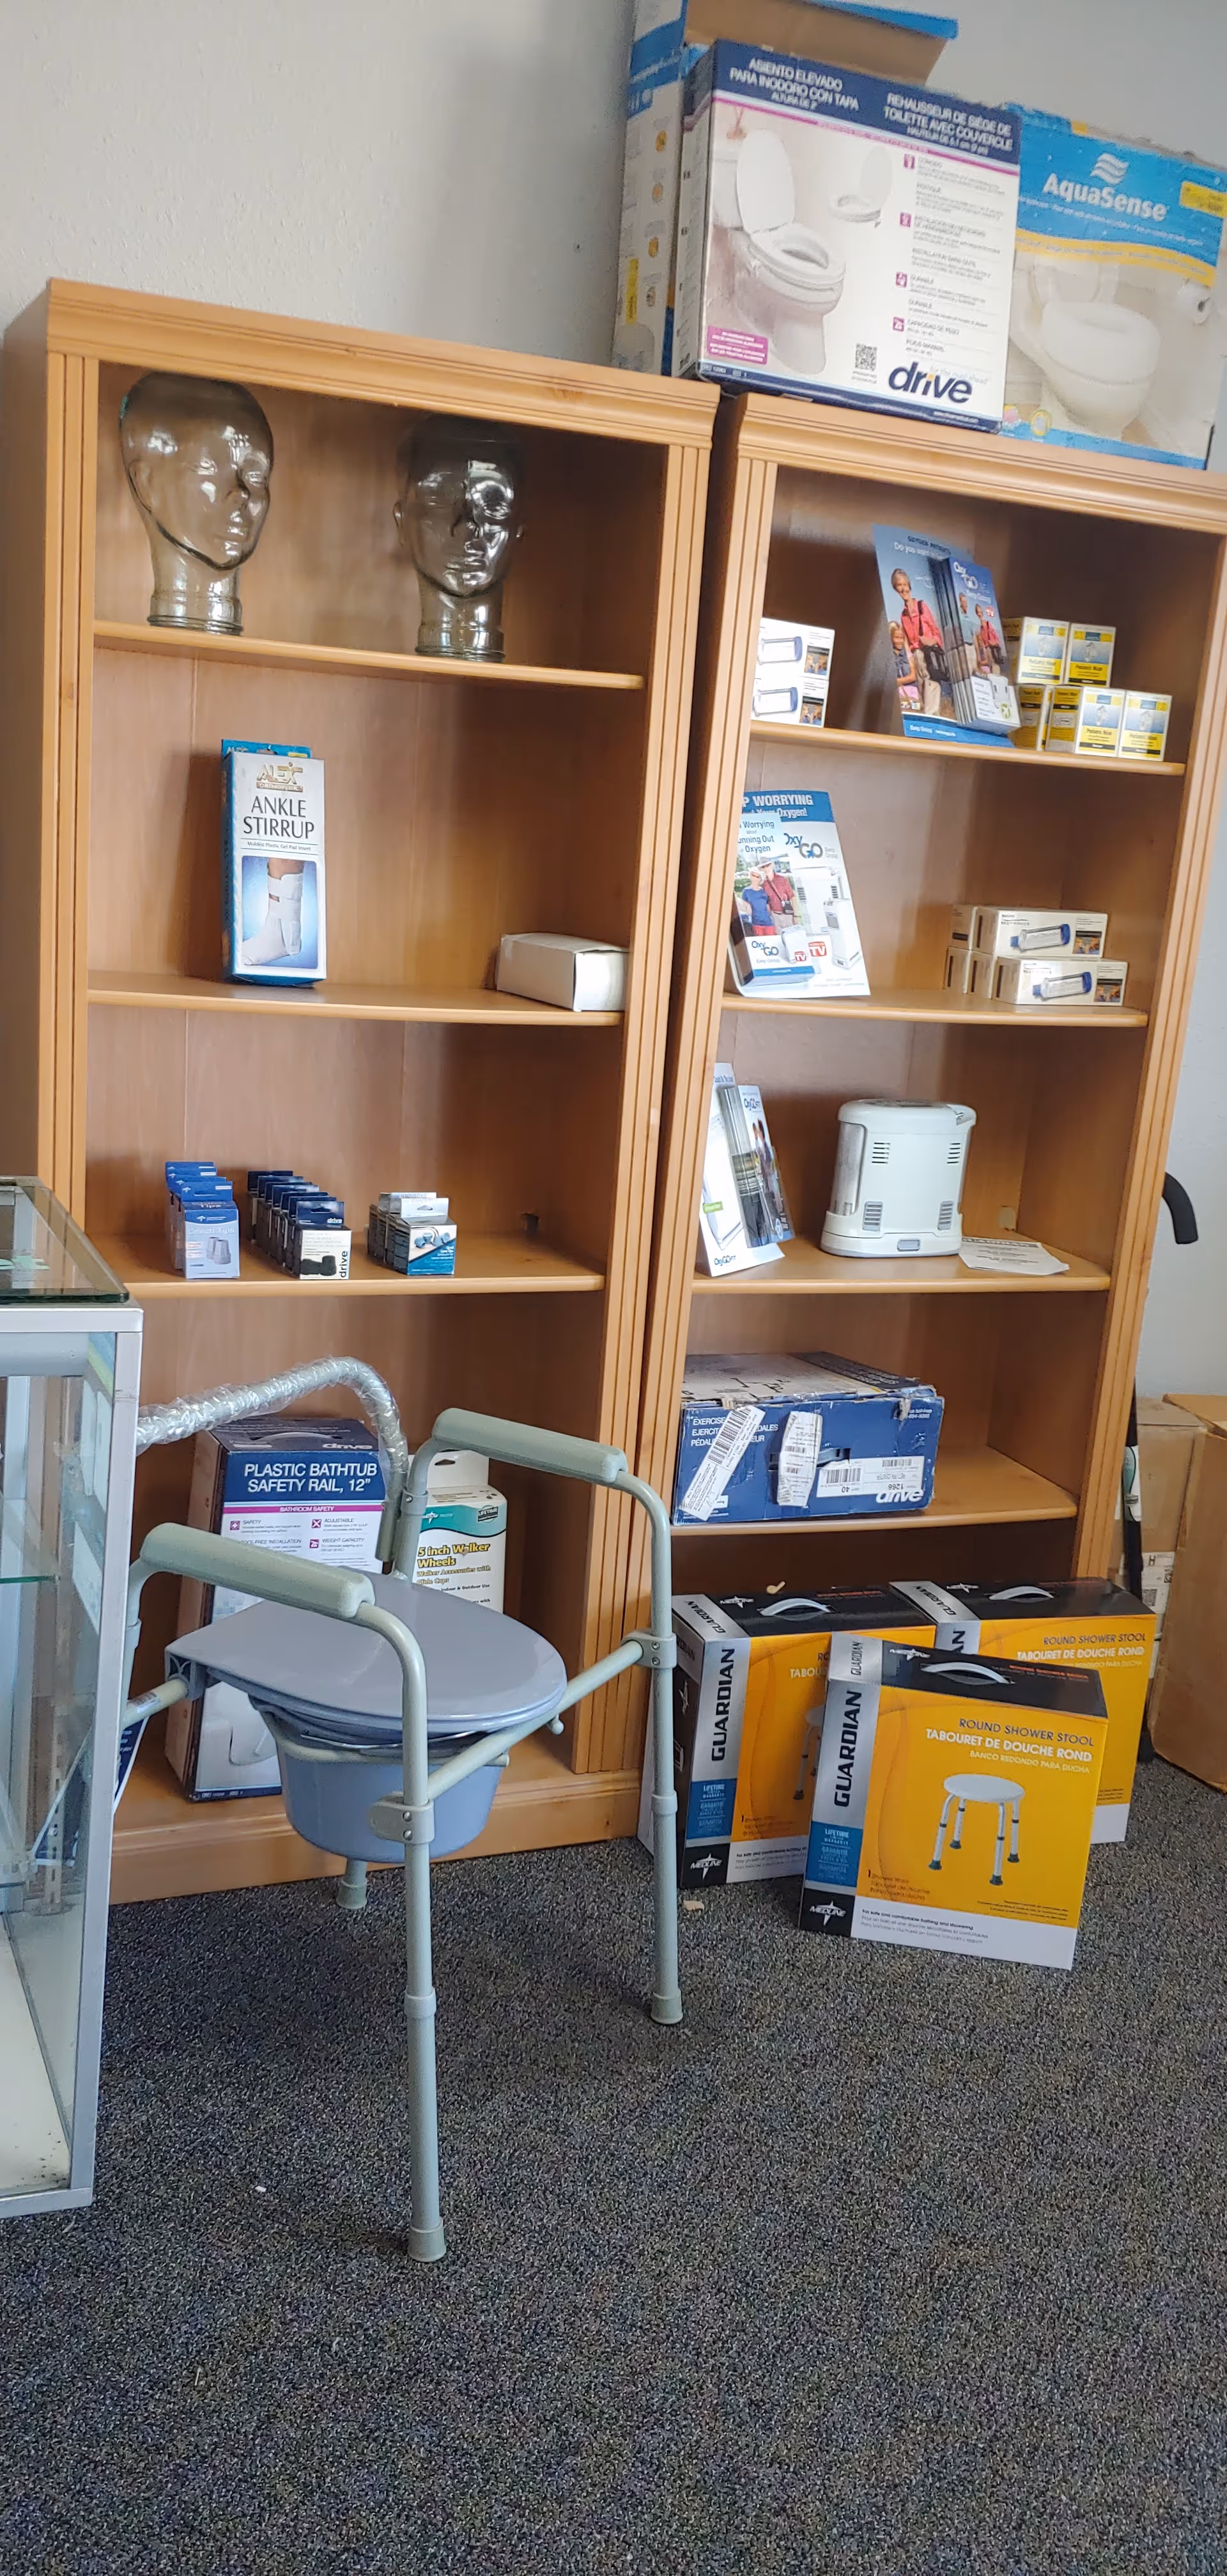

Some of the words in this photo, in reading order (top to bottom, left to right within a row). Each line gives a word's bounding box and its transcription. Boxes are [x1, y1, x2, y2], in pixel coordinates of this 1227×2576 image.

[748, 58, 794, 81] ASIENTO
[795, 70, 843, 93] ELEVADO
[730, 67, 757, 86] PARA
[759, 75, 808, 97] INODORO
[809, 86, 832, 104] CON
[835, 93, 860, 111] TAPA
[887, 92, 952, 122] REHAUSSEUR
[953, 111, 967, 125] DE
[998, 121, 1012, 137] DE
[884, 106, 929, 127] TOILETTE
[929, 118, 955, 136] AVEC
[956, 125, 1013, 151] COUVERCLE
[1042, 173, 1168, 222] AquaSense
[888, 361, 973, 403] drive
[251, 796, 307, 818] ANKLE
[752, 795, 814, 807] WORRYING
[777, 808, 808, 818] Oxygen!
[243, 816, 314, 839] STIRRUP
[752, 940, 766, 950] Oxy
[810, 946, 825, 957] TV
[339, 1251, 348, 1278] drive
[692, 1427, 720, 1436] EJERCIT
[245, 1463, 306, 1477] PLASTIC
[310, 1463, 377, 1477] BATHTUB
[247, 1479, 305, 1493] SAFETY
[308, 1480, 343, 1494] RAIL,
[876, 1489, 924, 1503] drive
[479, 1507, 498, 1516] LIFETIME
[418, 1547, 426, 1557] 5
[428, 1544, 450, 1556] inch
[452, 1542, 491, 1555] Walker
[417, 1557, 456, 1568] Wheels
[1148, 1555, 1156, 1565] H
[441, 1567, 475, 1575] Accessories
[720, 1597, 754, 1606] MEDLINE
[916, 1585, 957, 1616] GUARDIAN
[685, 1600, 726, 1633] GUARDIAN
[1044, 1636, 1076, 1645] ROUND
[1078, 1634, 1116, 1644] SHOWER
[1118, 1633, 1146, 1642] STOOL
[851, 1641, 863, 1676] GUARDIAN
[1017, 1649, 1062, 1661] TABOURET
[1063, 1649, 1075, 1658] DE
[1077, 1647, 1116, 1658] DOUCHE
[1118, 1646, 1145, 1656] ROND
[790, 1667, 828, 1678] TABOU
[711, 1648, 735, 1762] GUARDIAN
[959, 1718, 1001, 1733] ROUND
[1004, 1724, 1054, 1741] SHOWER
[1056, 1732, 1094, 1747] STOOL
[834, 1690, 863, 1808] GUARDIAN
[926, 1728, 983, 1747] TABOURET
[985, 1737, 1001, 1750] DE
[1003, 1740, 1054, 1757] DOUCHE
[1056, 1748, 1092, 1762] ROND
[970, 1750, 999, 1762] BANCO
[1000, 1754, 1040, 1767] REDONDO
[1040, 1760, 1060, 1771] PARA
[1062, 1763, 1090, 1774] DUCHA
[825, 1828, 849, 1838] LIFETIME
[690, 1859, 722, 1869] MEDLINE
[809, 1905, 846, 1917] MEDLINE
